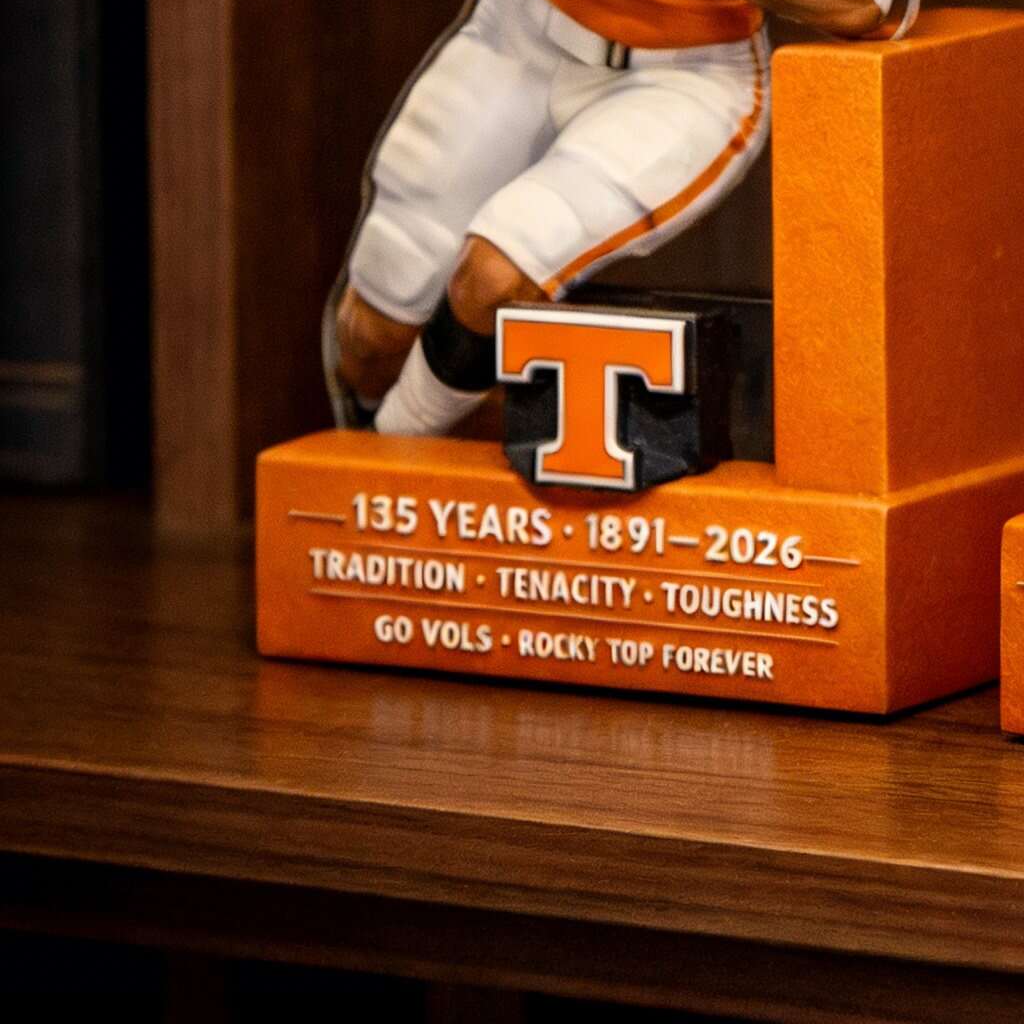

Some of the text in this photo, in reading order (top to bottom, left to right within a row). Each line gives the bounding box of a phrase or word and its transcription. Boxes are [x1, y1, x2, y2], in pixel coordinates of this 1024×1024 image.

[496, 308, 687, 490] T
[353, 494, 419, 535] 135
[428, 498, 554, 546] YEARS
[309, 548, 840, 629] TRADITION TENACITY TOUGHNESS
[374, 615, 774, 680] GO VOLS ROCKY TOP FOREVER
